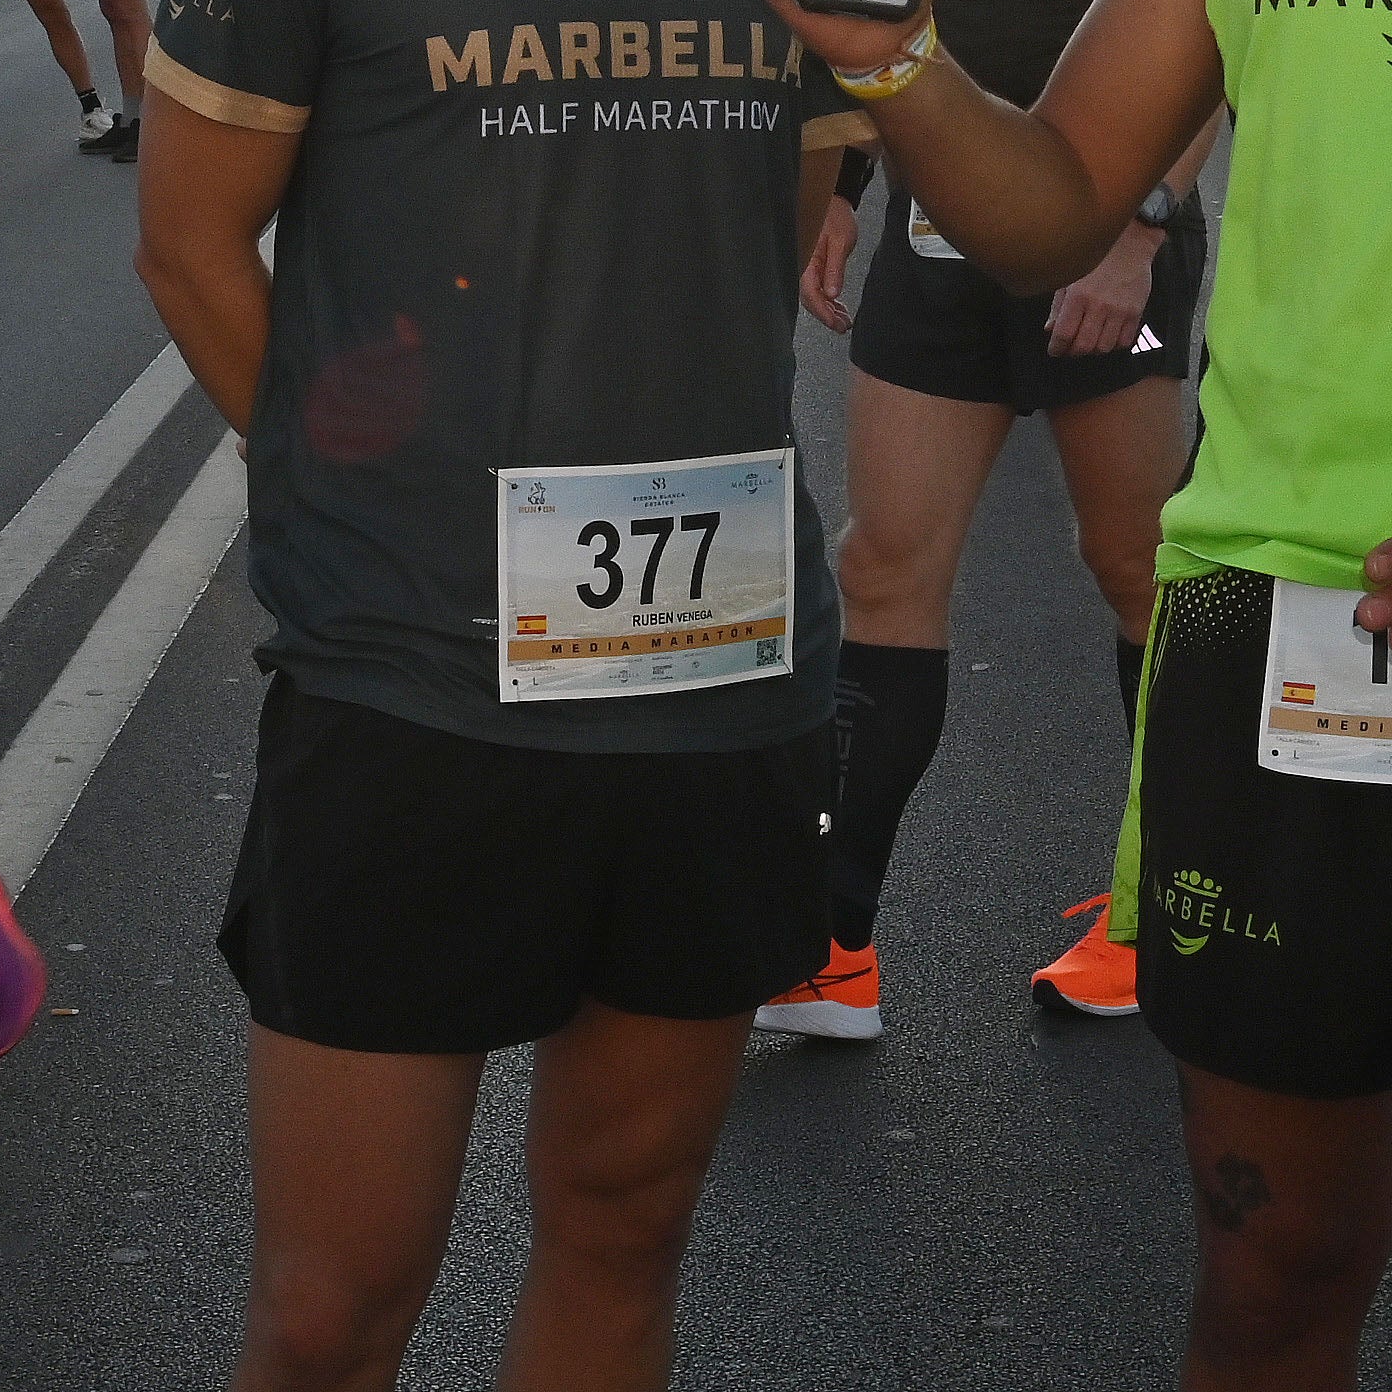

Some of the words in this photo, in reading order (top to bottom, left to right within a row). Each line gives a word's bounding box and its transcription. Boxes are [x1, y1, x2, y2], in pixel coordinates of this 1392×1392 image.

[424, 20, 804, 93] MARBELLA
[480, 95, 578, 139] HALF
[593, 98, 780, 134] MARATHON
[575, 511, 721, 610] 377
[632, 610, 674, 628] RUBEN
[676, 608, 713, 623] VENEGA
[551, 640, 630, 655] MEDIA
[1293, 750, 1299, 760] L
